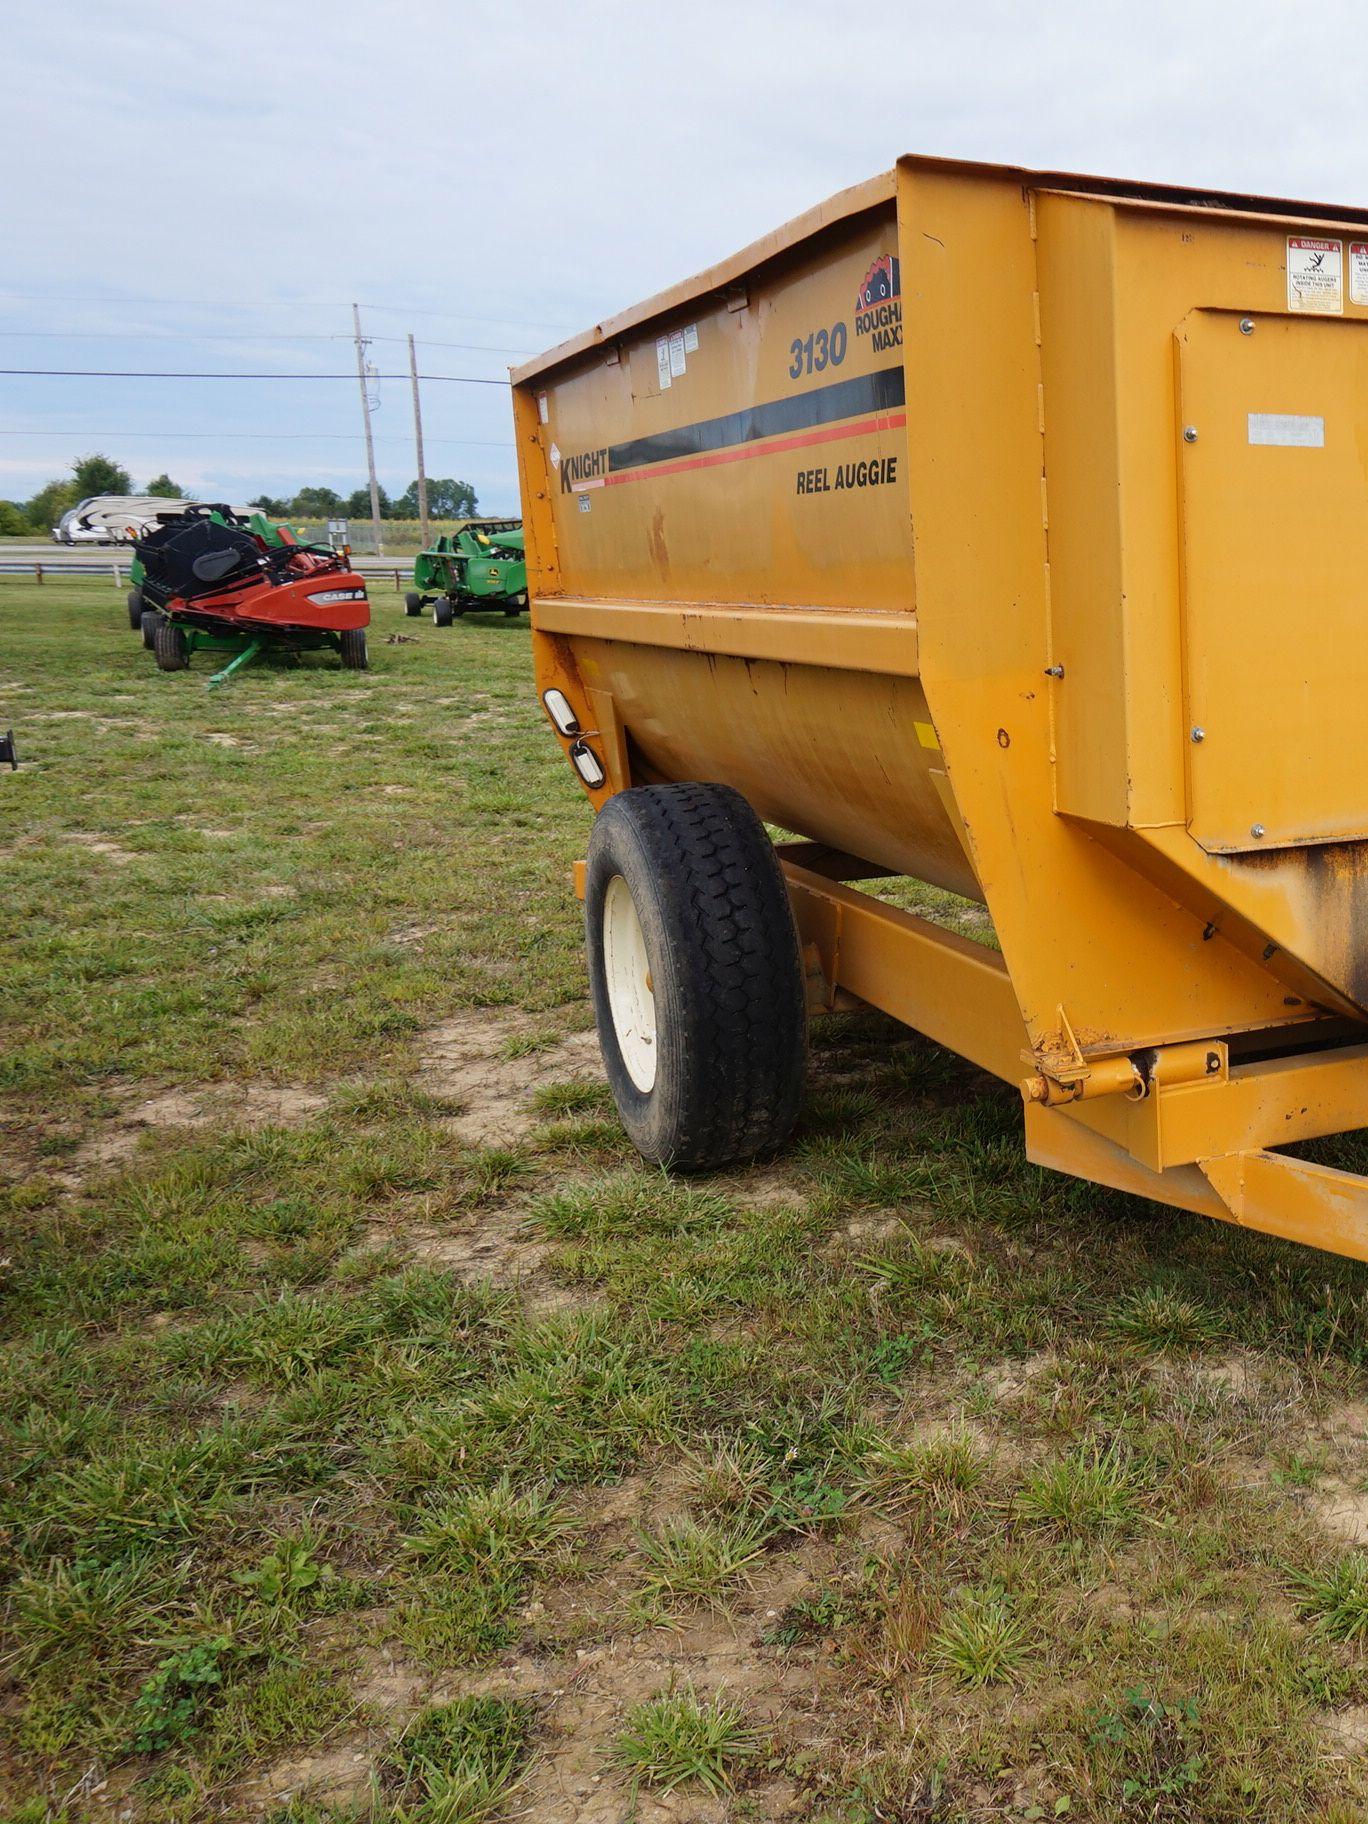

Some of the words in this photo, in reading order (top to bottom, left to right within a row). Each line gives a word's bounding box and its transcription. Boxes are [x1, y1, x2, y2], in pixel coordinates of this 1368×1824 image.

[1300, 240, 1330, 251] DANGER
[1293, 274, 1317, 282] ROTATING
[855, 302, 902, 337] ROUGH
[789, 321, 848, 380] 3130
[560, 448, 607, 495] KNIGHT
[796, 467, 831, 495] REEL
[835, 457, 898, 491] AUGGIE
[322, 592, 354, 601] CASE
